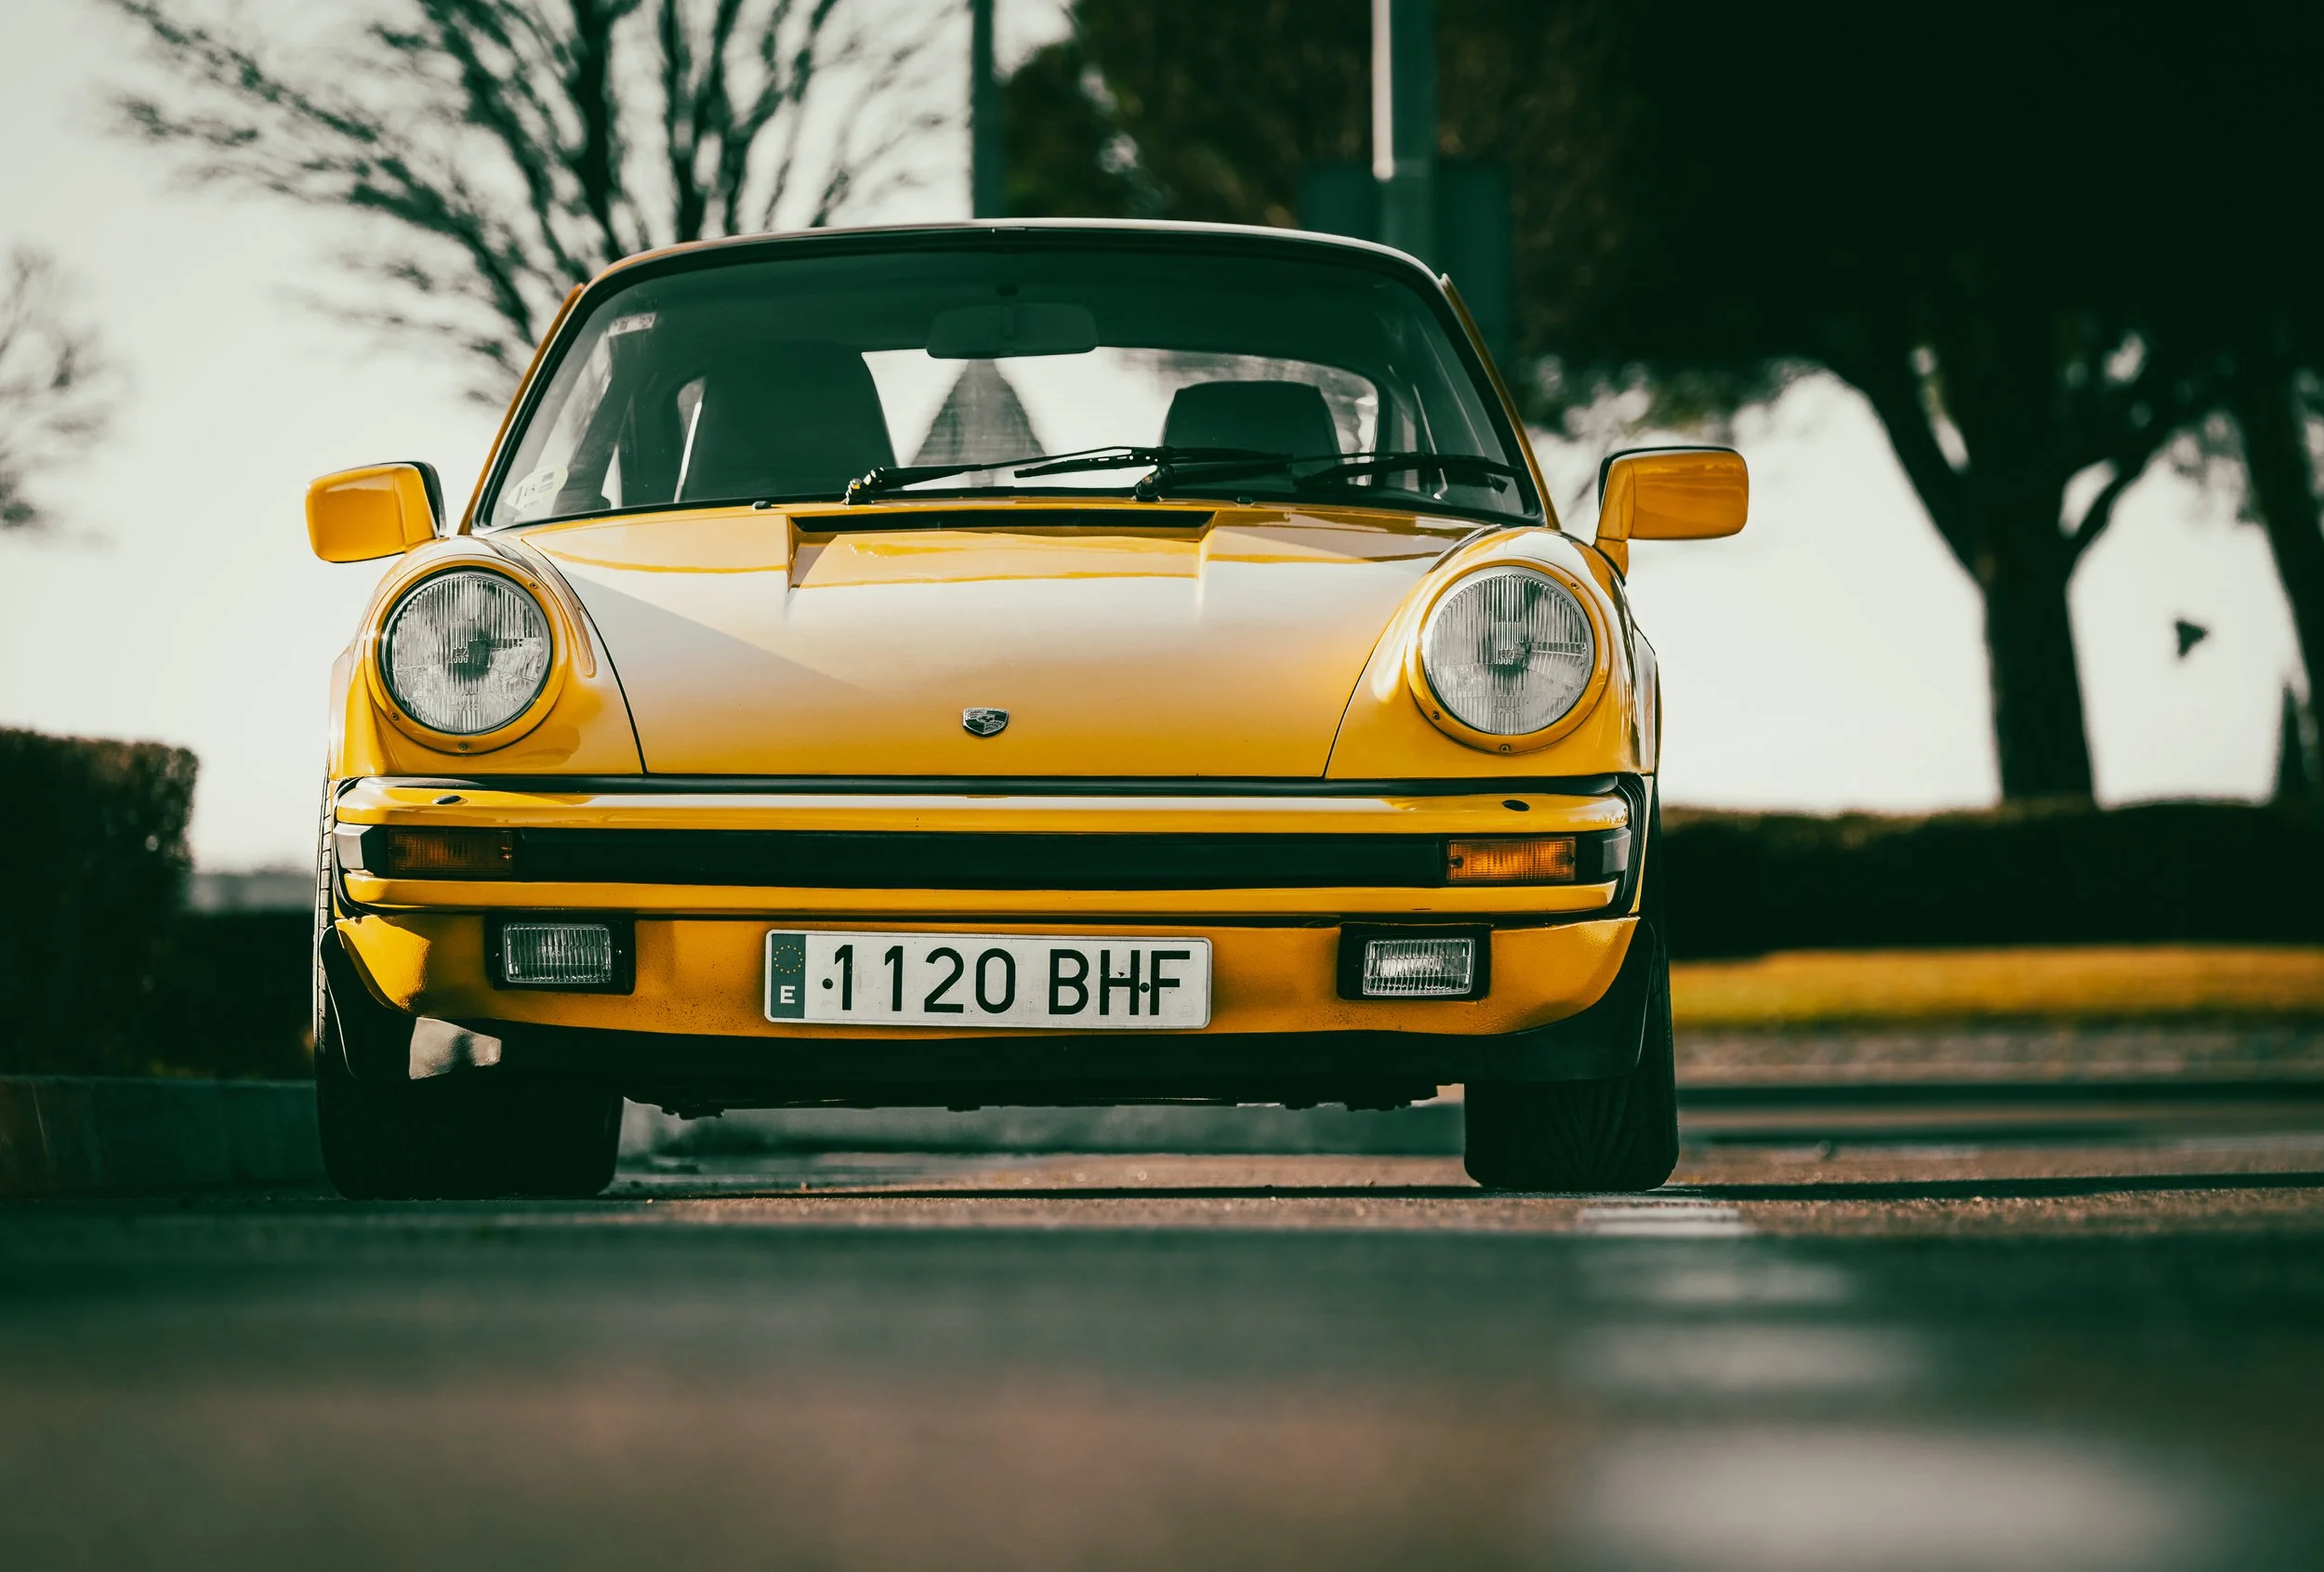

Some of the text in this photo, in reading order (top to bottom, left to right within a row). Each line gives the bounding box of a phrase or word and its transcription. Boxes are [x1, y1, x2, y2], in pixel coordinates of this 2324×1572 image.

[780, 984, 796, 1004] E
[834, 944, 1191, 1016] 1120 BHF
